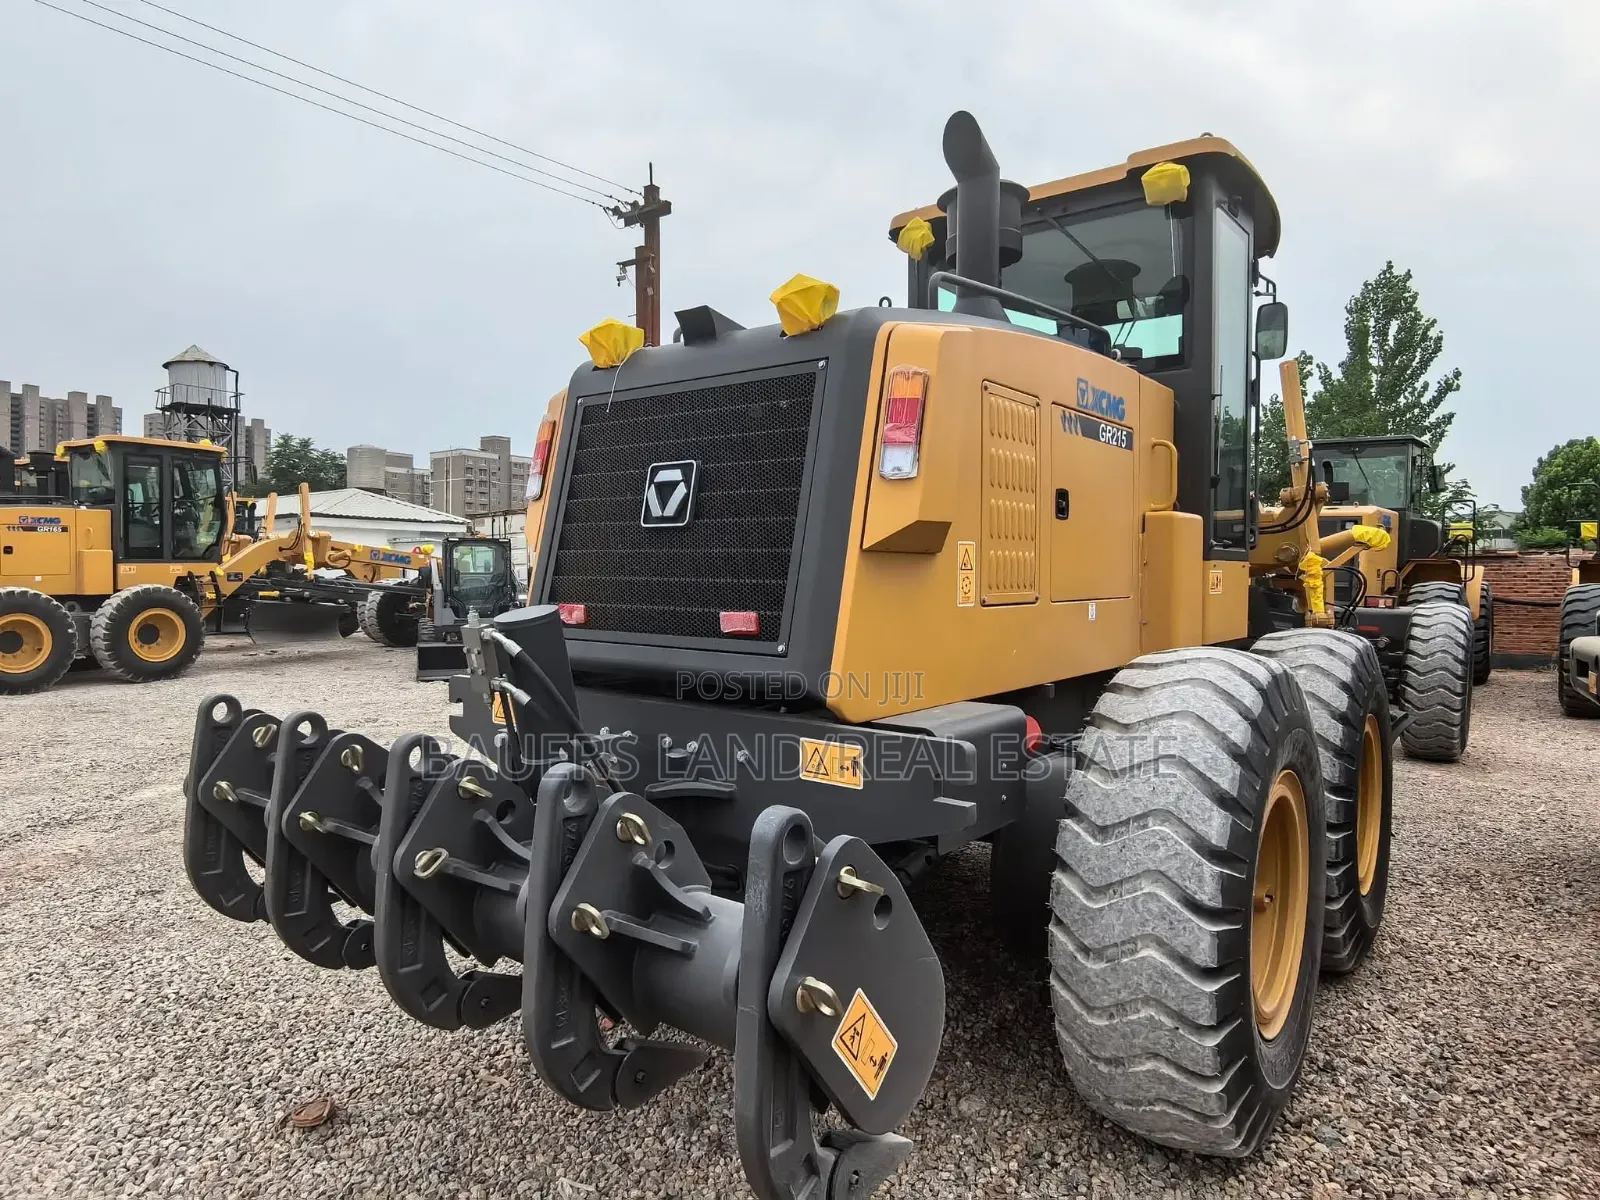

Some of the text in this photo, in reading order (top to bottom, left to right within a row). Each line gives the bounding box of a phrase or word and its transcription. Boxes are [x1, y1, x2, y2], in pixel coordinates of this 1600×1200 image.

[1087, 386, 1126, 422] XCMG
[1099, 423, 1127, 448] GR215
[30, 517, 62, 525] XCMG
